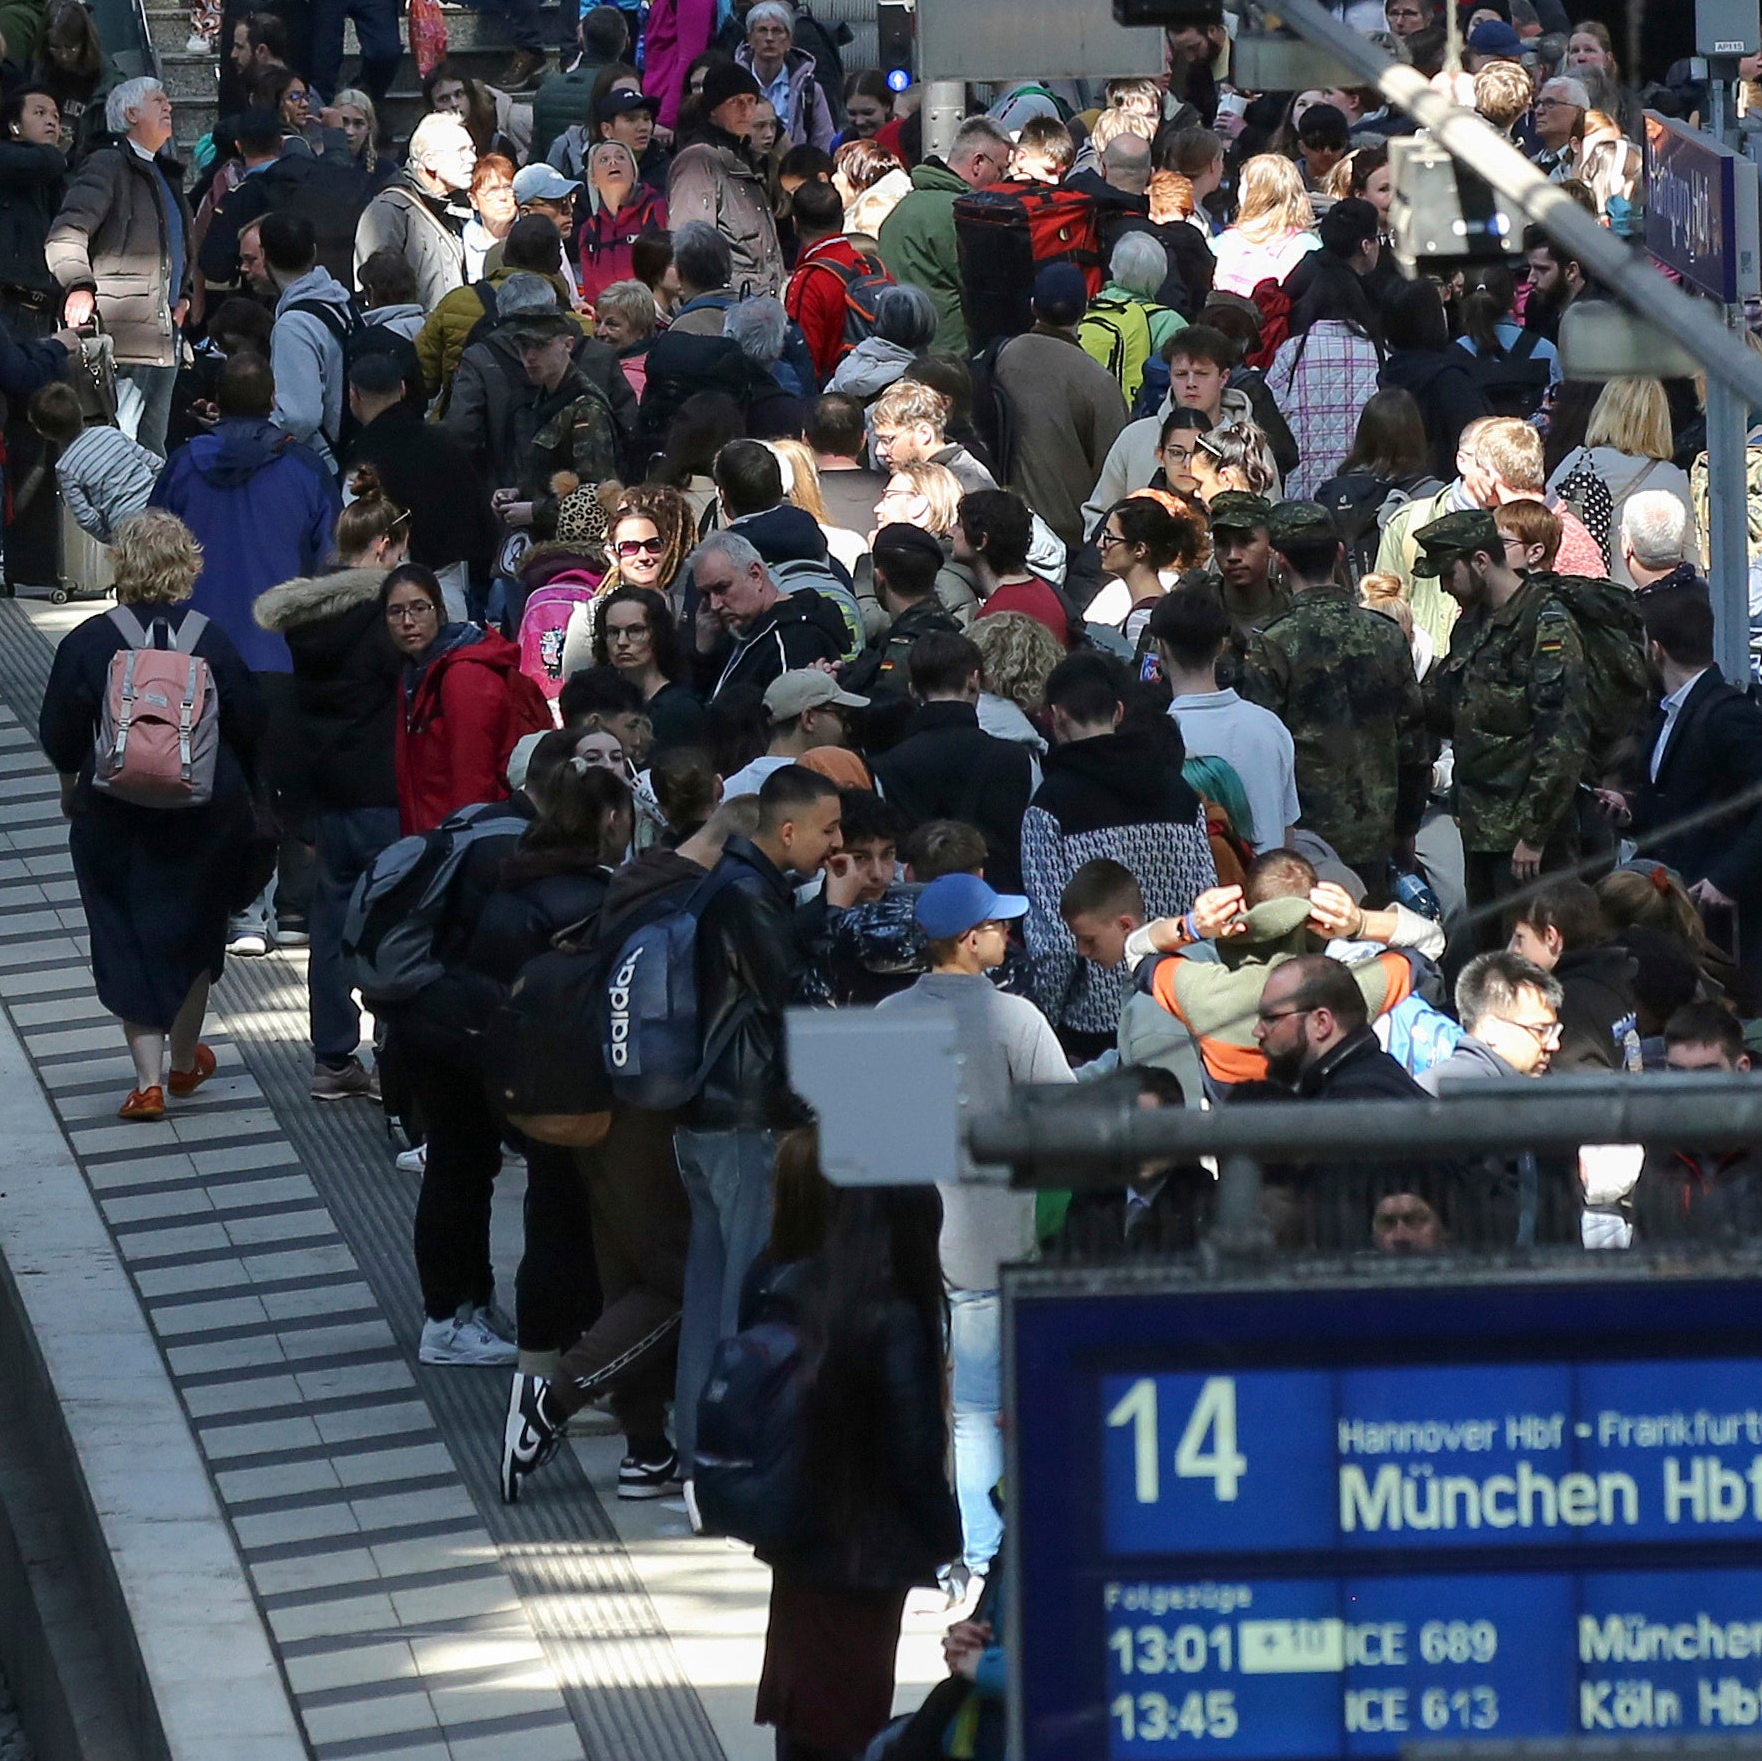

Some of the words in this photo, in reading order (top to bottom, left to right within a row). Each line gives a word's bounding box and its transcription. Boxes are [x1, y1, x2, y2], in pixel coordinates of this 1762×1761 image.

[1716, 42, 1744, 52] AP115
[609, 947, 644, 1067] adidas
[1107, 1376, 1246, 1503] 14
[1338, 1419, 1494, 1456] Hannover
[1506, 1414, 1565, 1451] Hbf
[1340, 1464, 1638, 1532] München
[1105, 1582, 1252, 1613] Folgezüge
[1110, 1627, 1234, 1675] 13:01
[1346, 1622, 1407, 1668] ICE
[1421, 1620, 1497, 1665] 689
[1111, 1692, 1238, 1741] 13:45
[1346, 1690, 1407, 1732] ICE
[1421, 1688, 1498, 1730] 613
[1580, 1682, 1679, 1730] Köln
